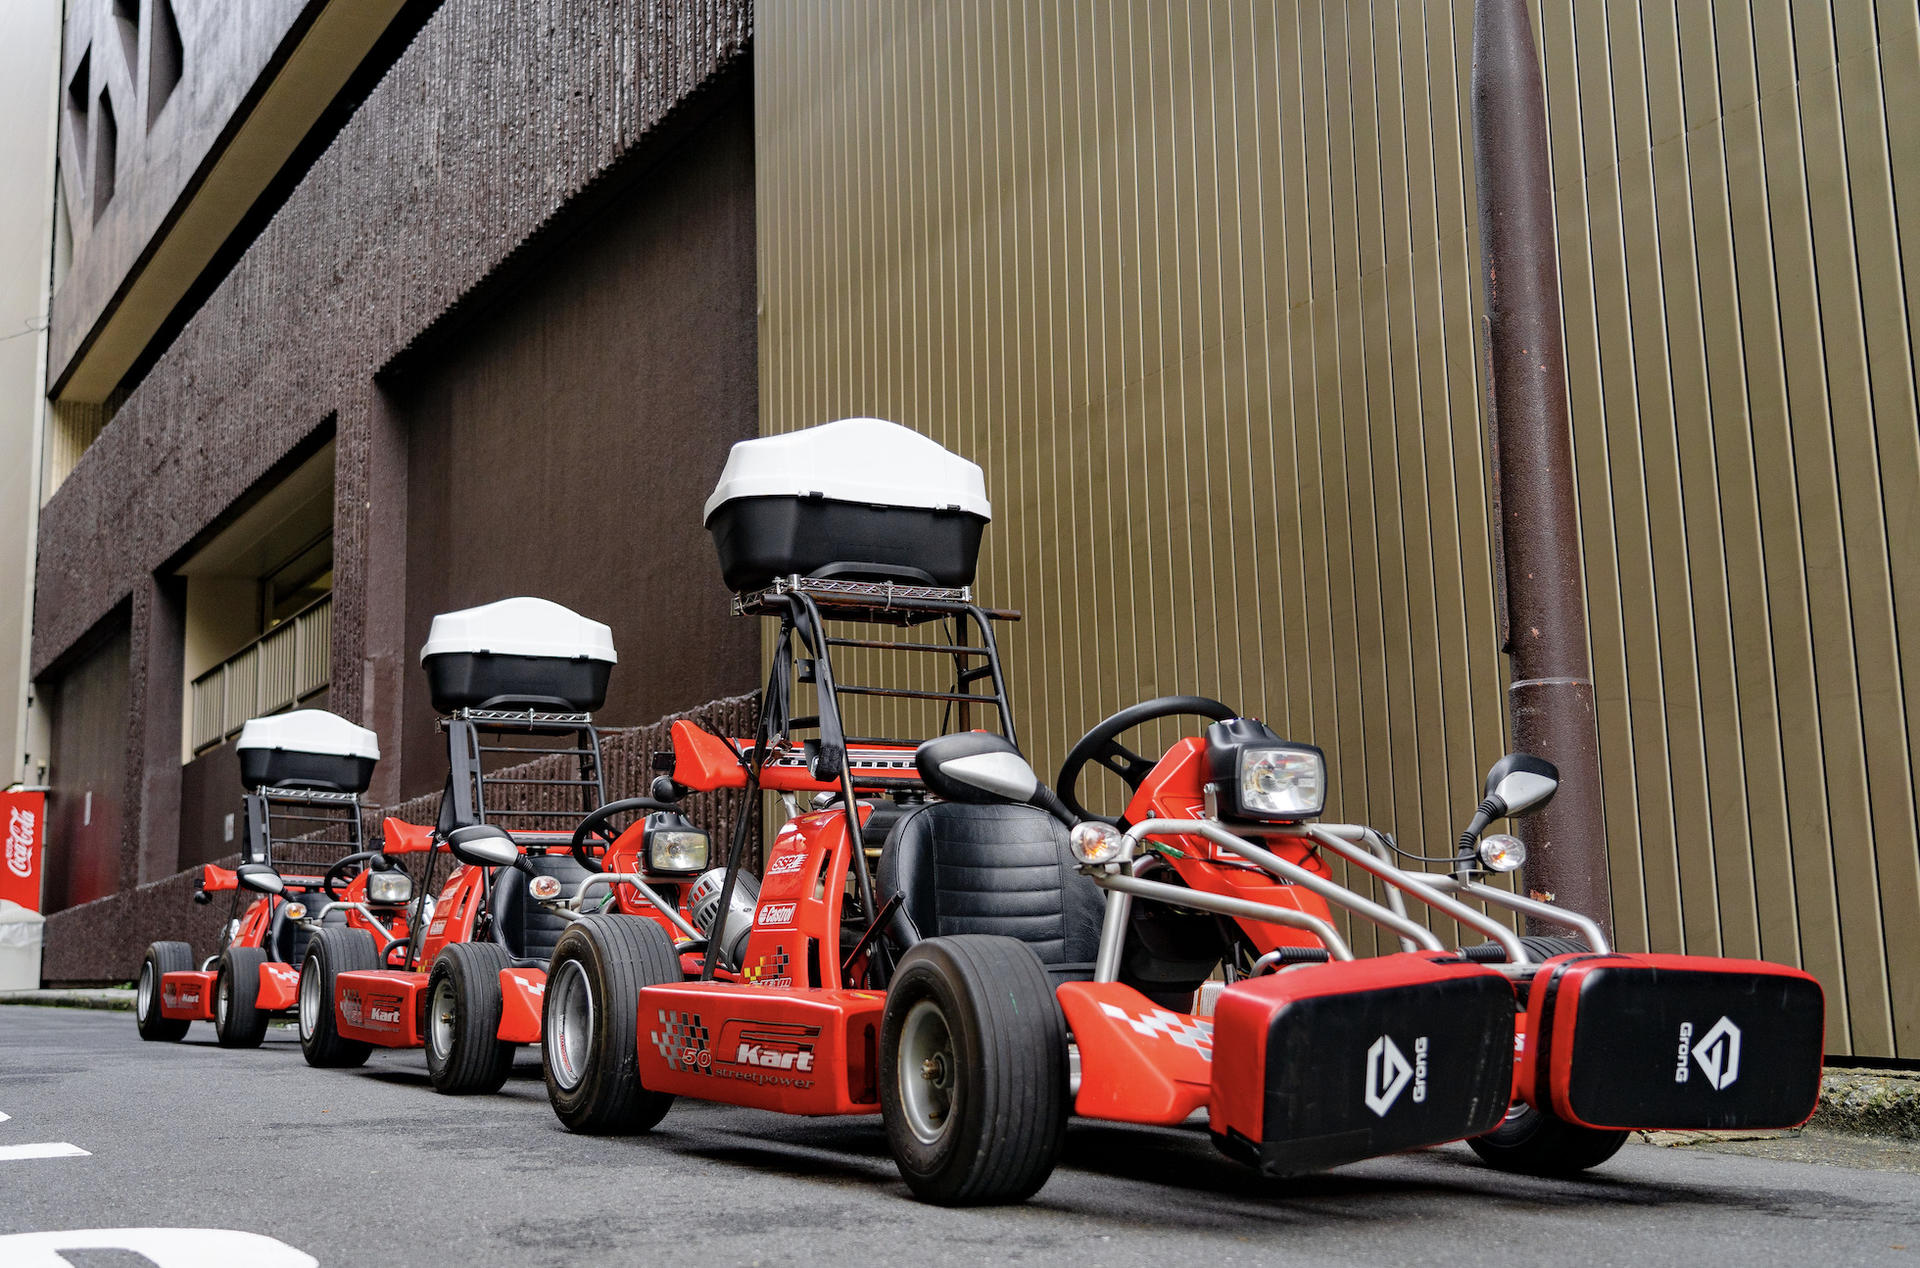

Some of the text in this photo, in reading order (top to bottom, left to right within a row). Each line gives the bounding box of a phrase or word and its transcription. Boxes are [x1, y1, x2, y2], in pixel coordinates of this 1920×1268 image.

[766, 906, 791, 922] Castrol
[371, 1007, 400, 1023] Kart
[683, 1047, 711, 1067] 50
[737, 1043, 814, 1072] Kart
[716, 1069, 815, 1089] streetpower
